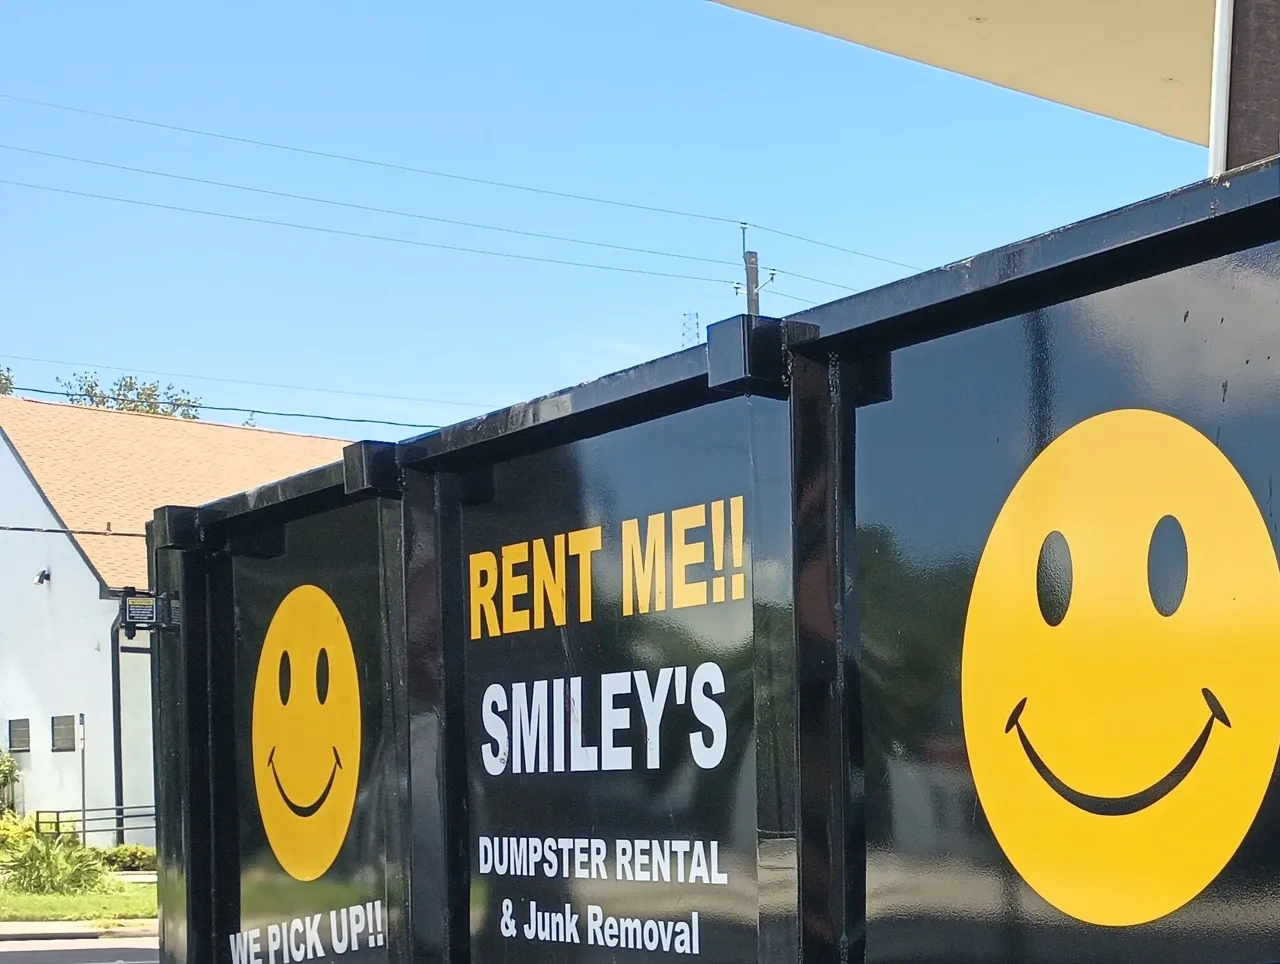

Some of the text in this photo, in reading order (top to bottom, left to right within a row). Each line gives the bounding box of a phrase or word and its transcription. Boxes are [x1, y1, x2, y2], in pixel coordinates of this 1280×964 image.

[469, 495, 745, 641] RENT ME!!
[481, 661, 728, 776] SMILEY'S
[478, 836, 728, 885] DUMPSTER RENTAL
[329, 900, 385, 954] UP!!
[500, 898, 700, 955] & Junk Removal
